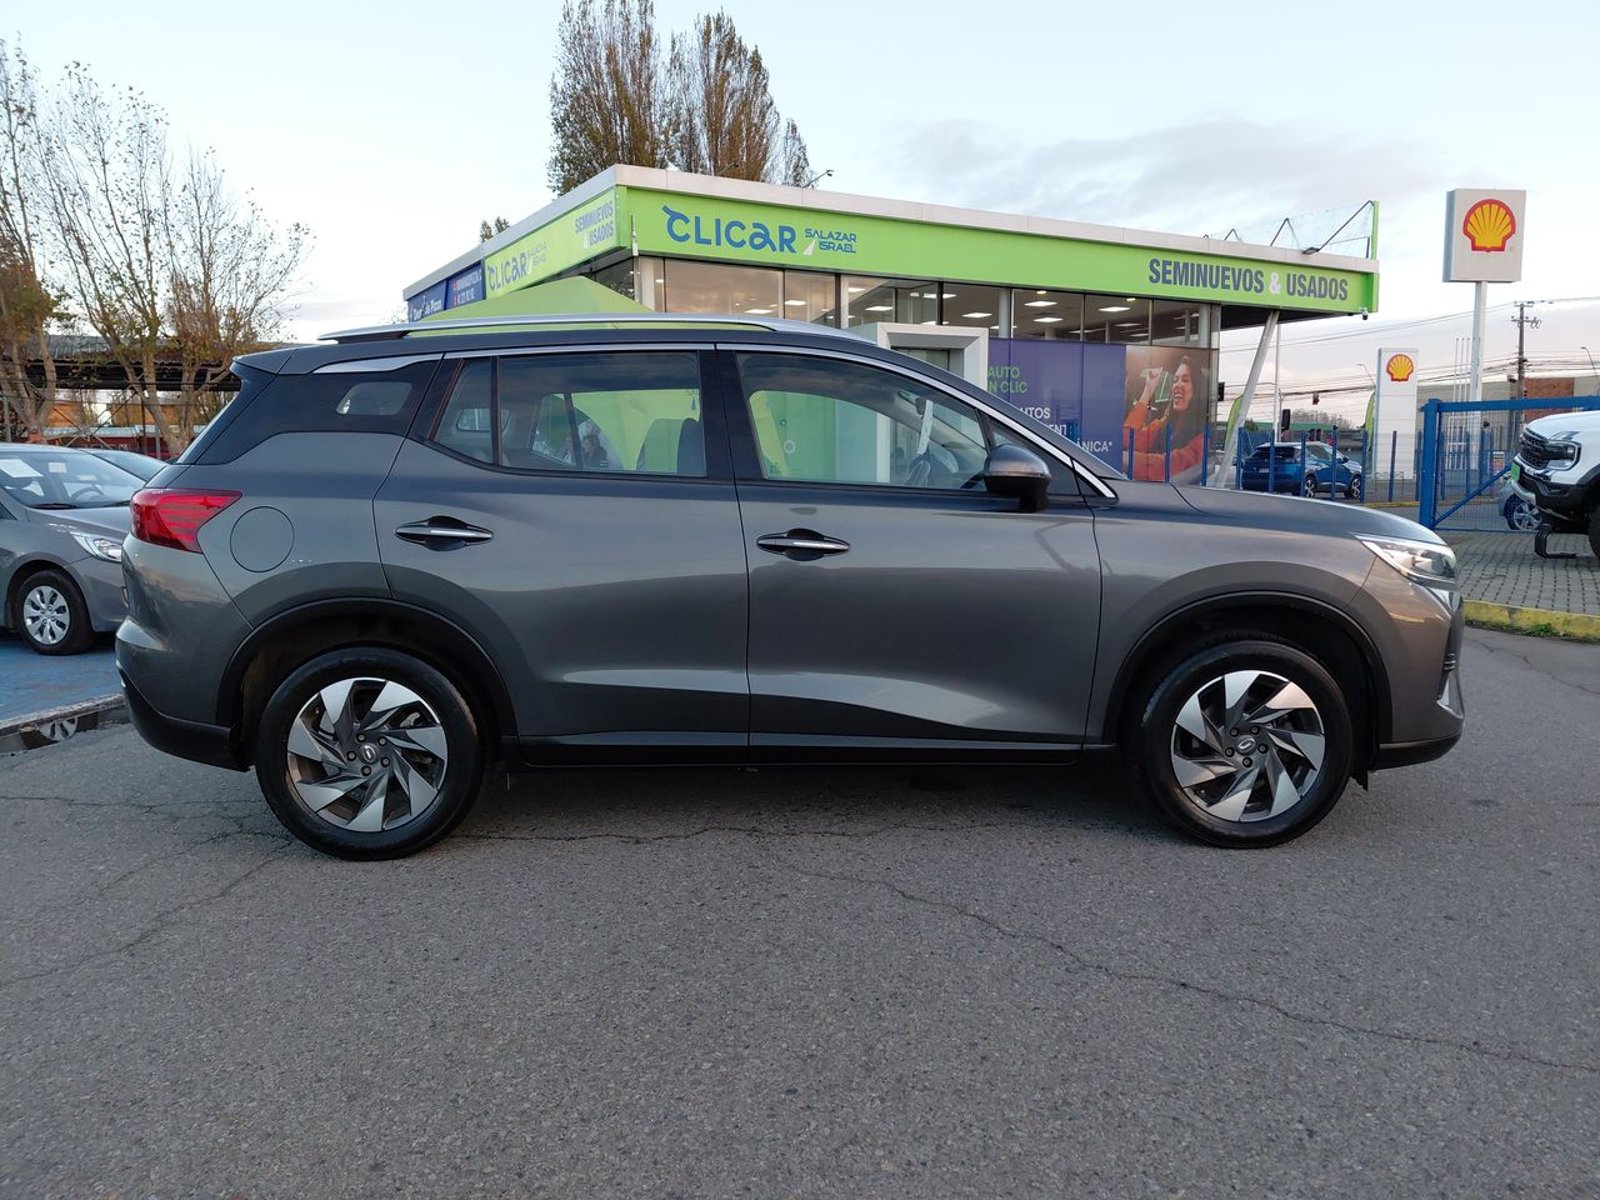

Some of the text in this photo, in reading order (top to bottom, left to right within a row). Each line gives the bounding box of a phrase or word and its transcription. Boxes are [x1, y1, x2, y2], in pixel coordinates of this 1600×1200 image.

[804, 228, 857, 242] SALAZAR
[819, 241, 857, 254] ISRAEL
[1149, 258, 1348, 301] SEMINUEVOS & USADOS
[987, 366, 1020, 379] AUTO
[988, 380, 1028, 394] N CLIC
[1019, 407, 1051, 419] UTOS
